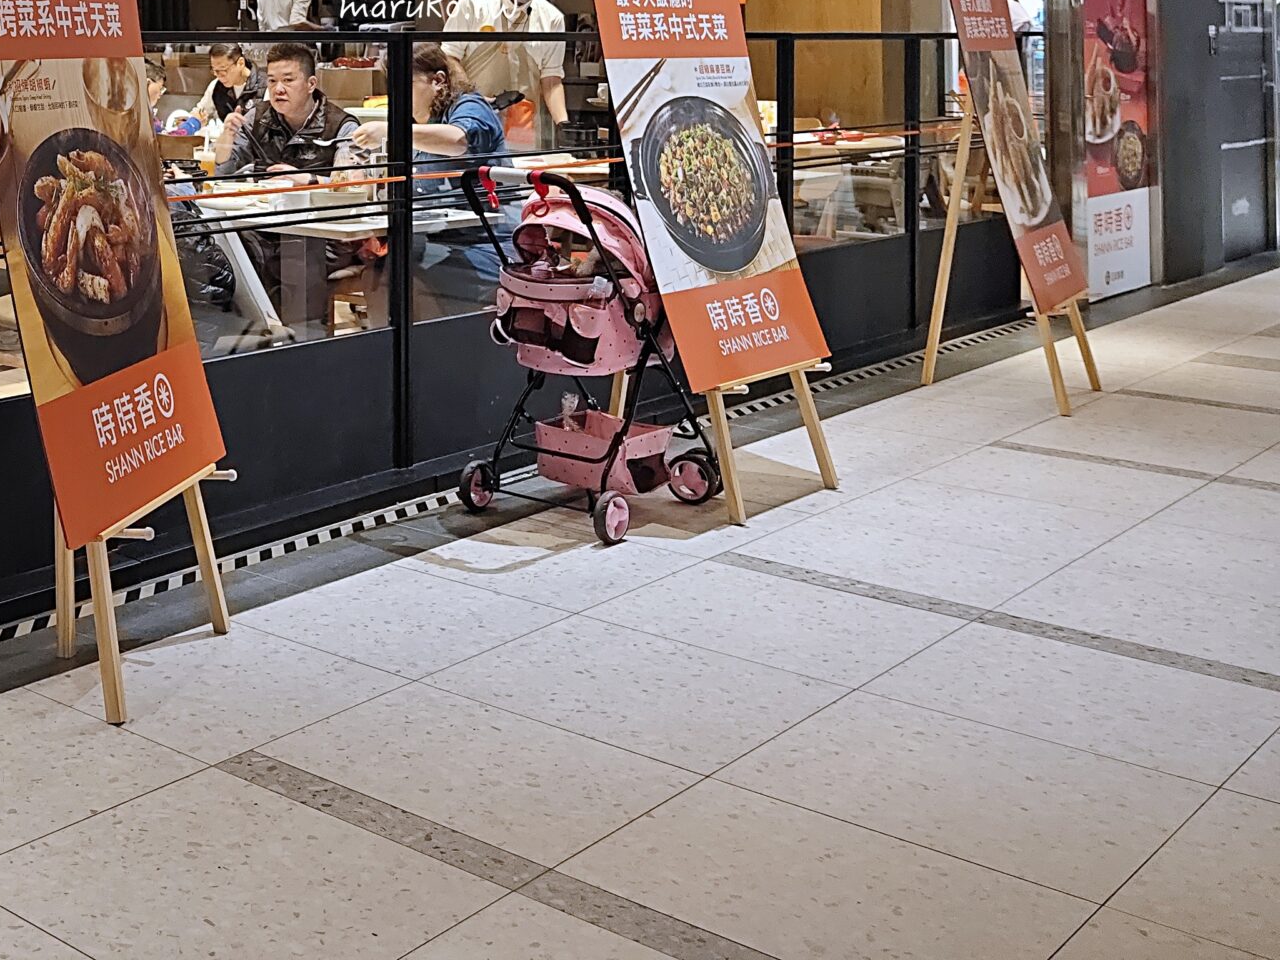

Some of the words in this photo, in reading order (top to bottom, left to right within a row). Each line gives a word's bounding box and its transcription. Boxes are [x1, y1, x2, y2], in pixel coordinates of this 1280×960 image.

[619, 12, 728, 41] 跨菜系中式天菜
[706, 292, 763, 332] 時時香
[719, 334, 753, 356] SHANN
[752, 329, 772, 347] RICE
[771, 325, 789, 342] BAR
[92, 382, 157, 448] 時時香
[105, 444, 145, 483] SHANN
[144, 432, 166, 461] RICE
[165, 423, 185, 449] BAR
